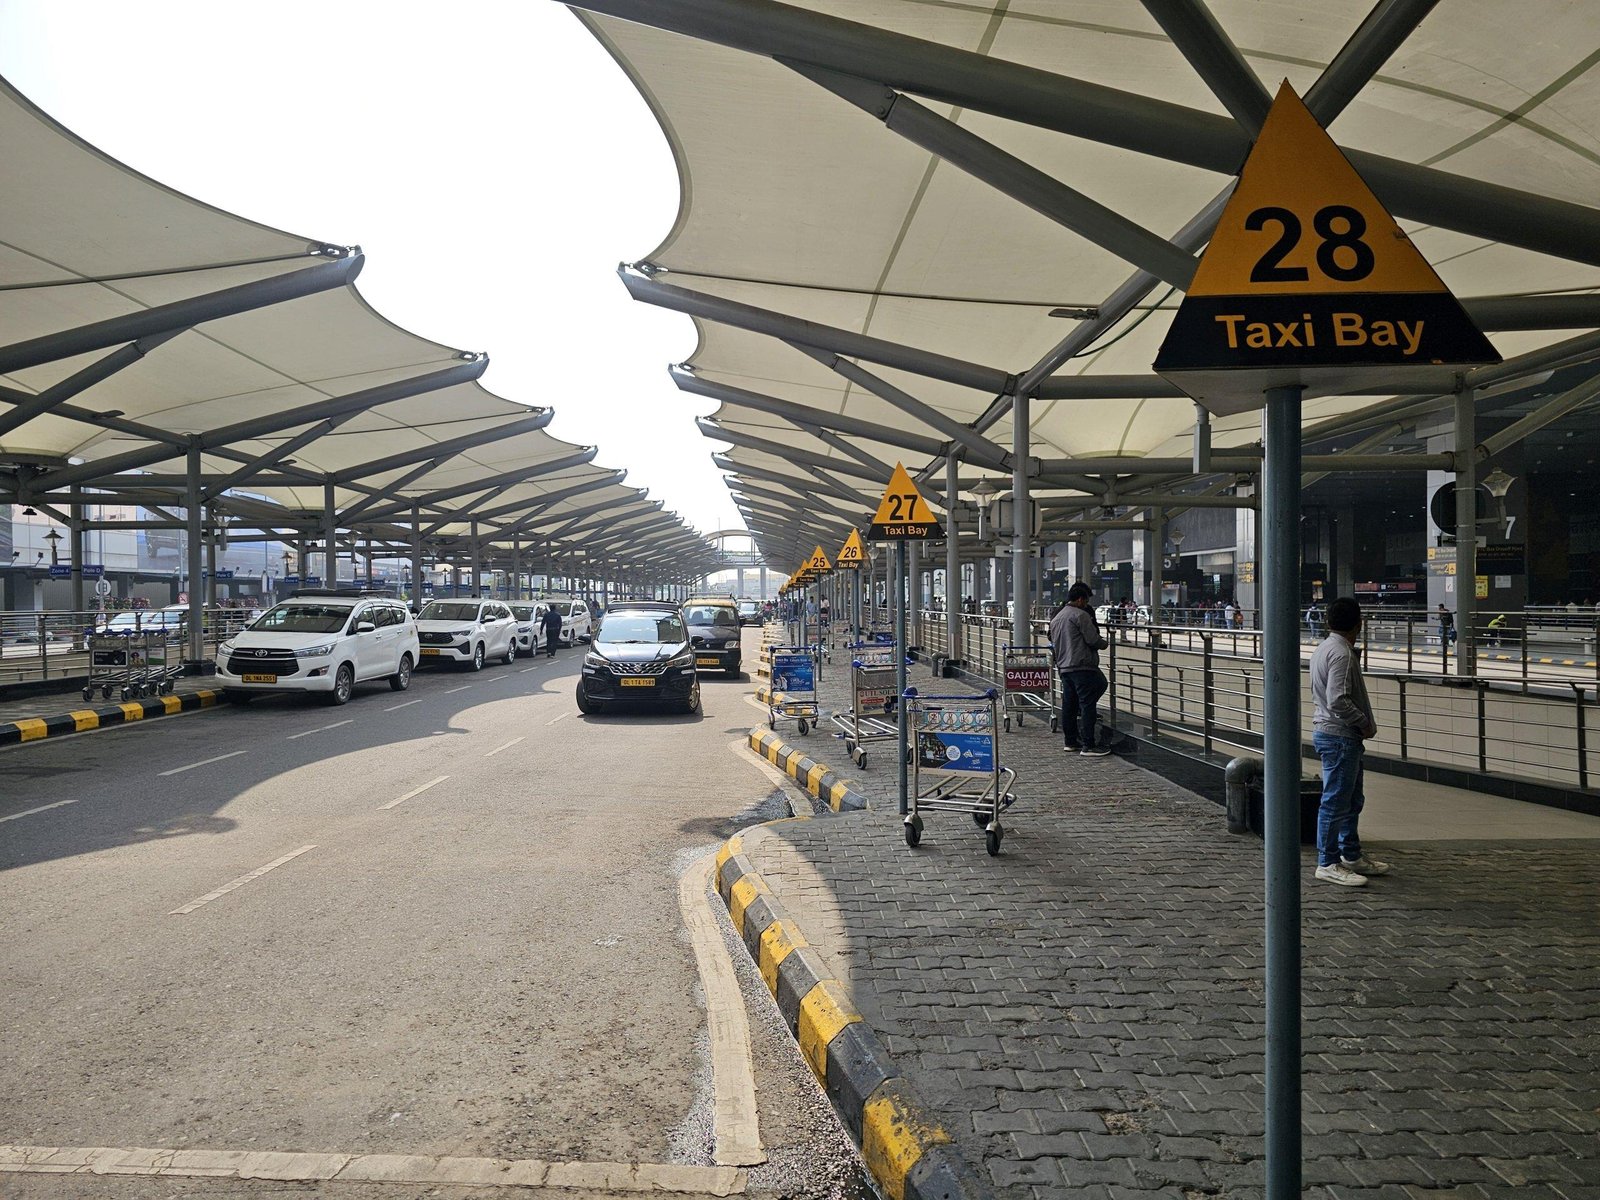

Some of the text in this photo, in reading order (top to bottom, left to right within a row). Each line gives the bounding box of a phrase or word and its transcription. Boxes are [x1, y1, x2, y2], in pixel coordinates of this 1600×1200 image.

[1244, 204, 1376, 283] 28
[1214, 312, 1426, 355] Taxi Bay
[887, 494, 918, 521] 27
[883, 525, 928, 537] Taxi Bay
[1505, 516, 1516, 540] 7
[843, 546, 858, 559] 26
[812, 557, 826, 568] 25
[1164, 558, 1172, 569] 5
[1043, 570, 1049, 579] 3
[1006, 671, 1049, 680] GAUTAM
